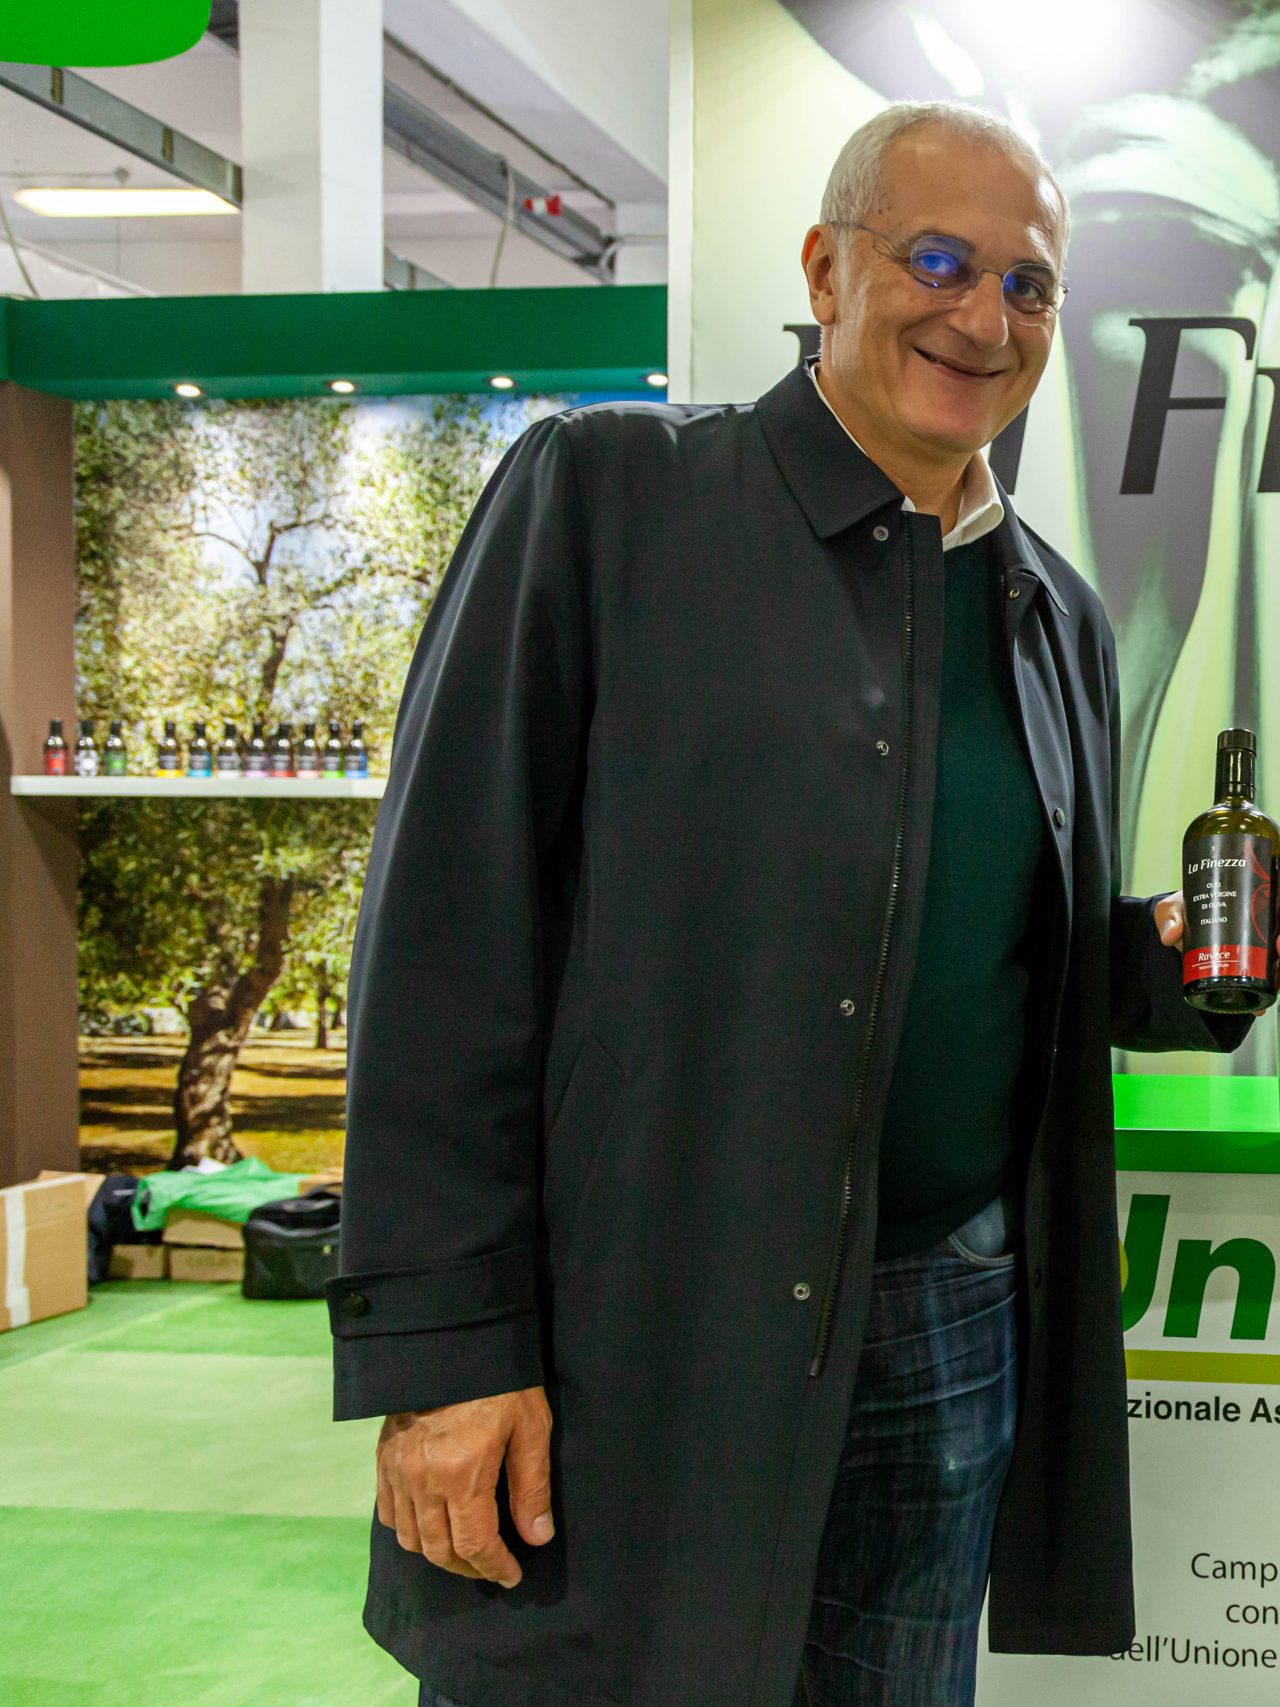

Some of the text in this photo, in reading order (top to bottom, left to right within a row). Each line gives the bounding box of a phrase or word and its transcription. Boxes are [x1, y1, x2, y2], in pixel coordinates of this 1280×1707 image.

[1188, 858, 1246, 875] La Finezza
[1193, 894, 1210, 902] EXTRA
[1200, 917, 1228, 925] ITALIANO
[1198, 951, 1231, 962] Ravece
[1225, 1603, 1279, 1624] con
